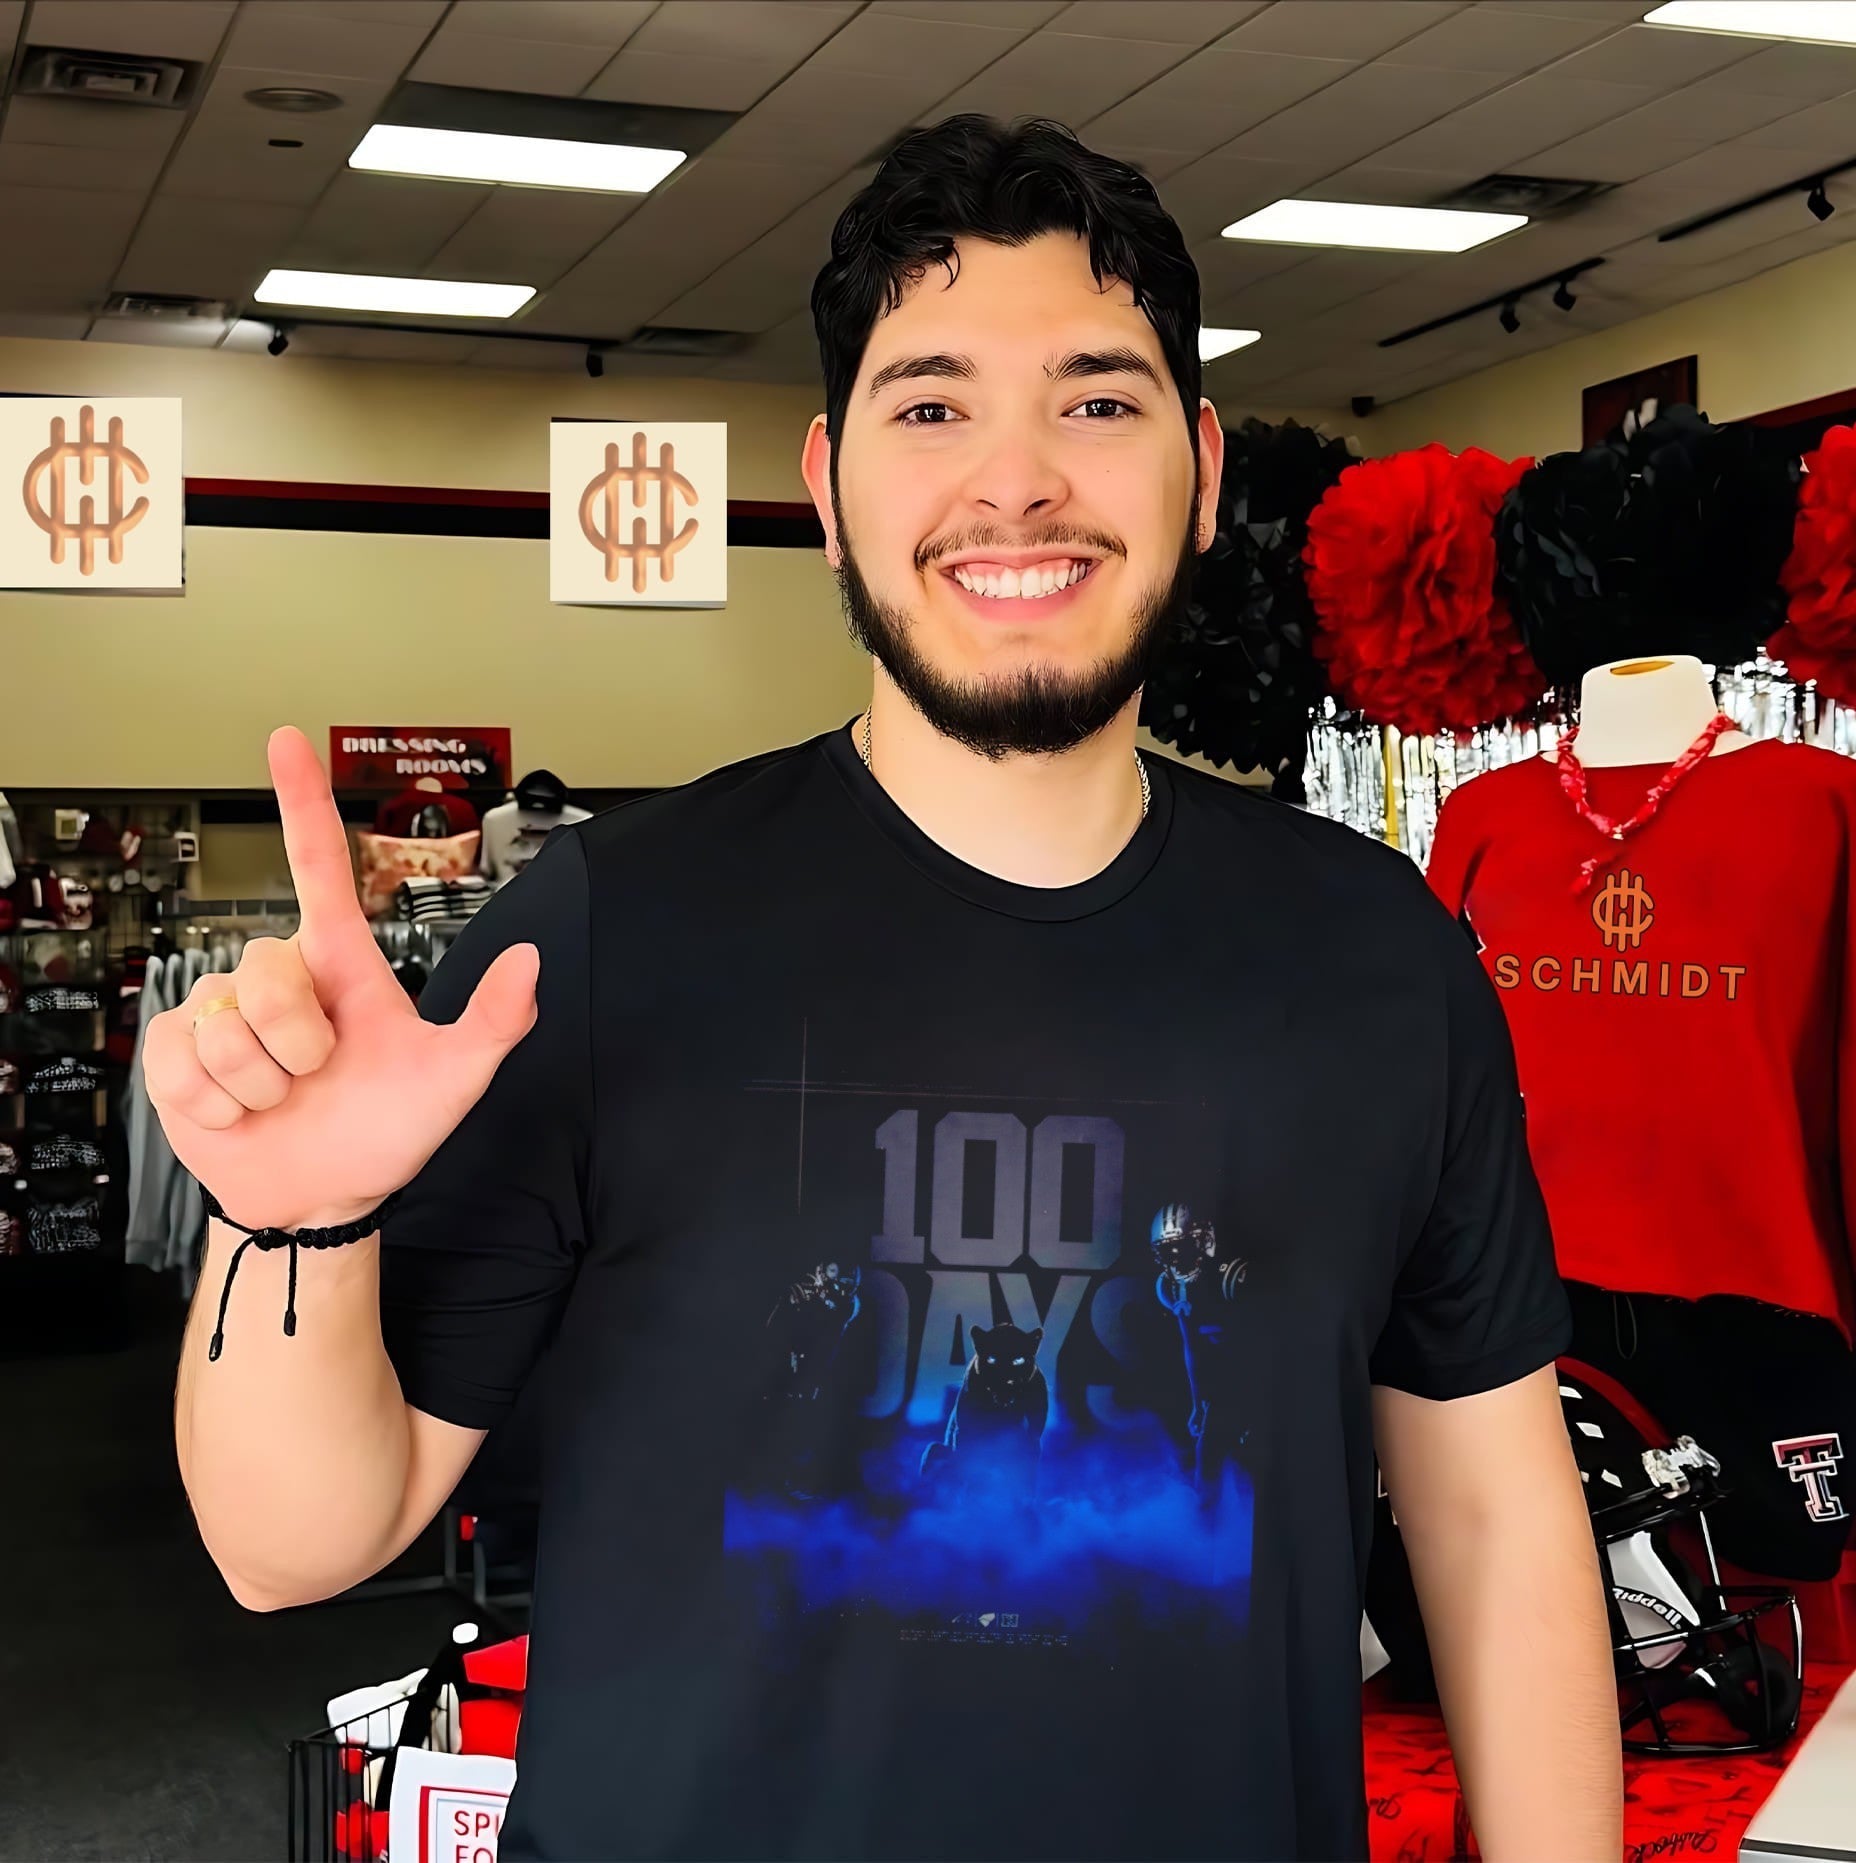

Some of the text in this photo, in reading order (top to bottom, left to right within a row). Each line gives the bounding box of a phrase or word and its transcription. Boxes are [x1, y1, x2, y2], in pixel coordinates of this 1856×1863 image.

[396, 758, 487, 775] ROOMS
[1493, 953, 1747, 1001] SCHMIDT
[870, 1109, 1126, 1271] 100
